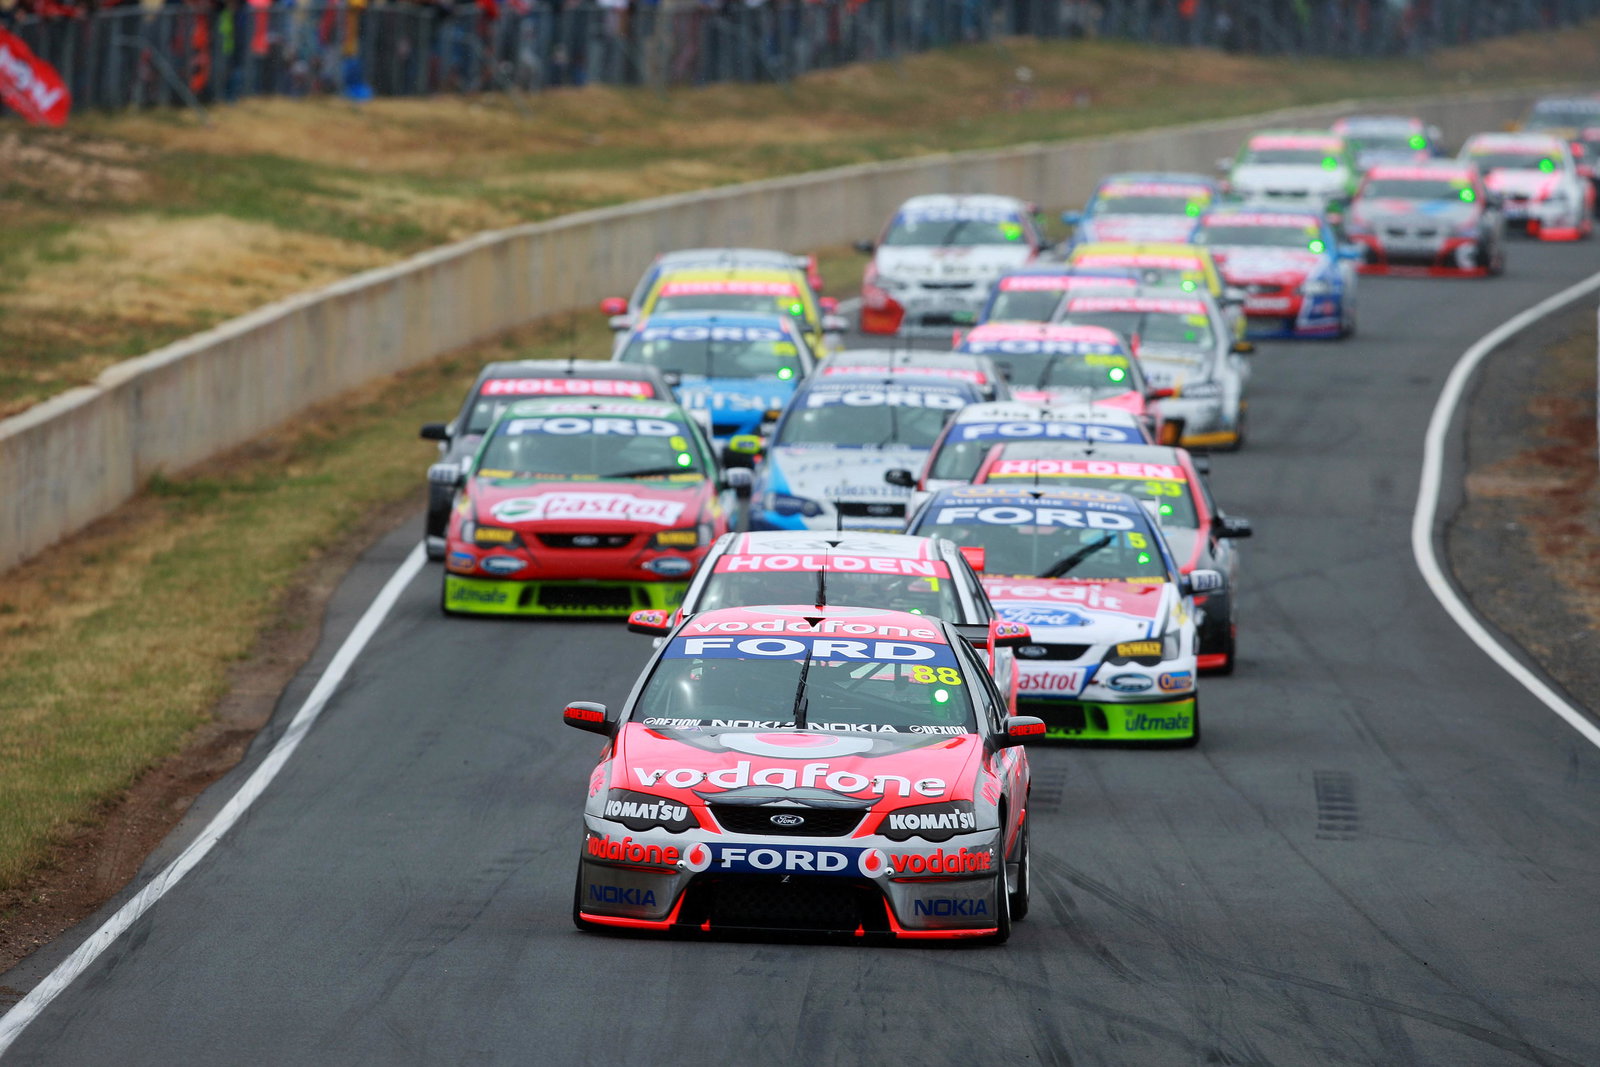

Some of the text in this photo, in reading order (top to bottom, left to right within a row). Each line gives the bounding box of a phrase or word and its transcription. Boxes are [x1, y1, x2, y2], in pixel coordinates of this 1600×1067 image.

[642, 327, 782, 341] FORD
[489, 379, 642, 396] HOLDEN
[807, 391, 965, 410] FORD
[506, 418, 679, 437] FORD
[962, 422, 1128, 442] FORD
[999, 460, 1174, 478] HOLDEN
[1145, 481, 1182, 498] 33
[541, 492, 671, 518] Castrol
[936, 506, 1135, 530] FORD
[1127, 532, 1147, 549] 5
[726, 554, 936, 577] HOLDEN
[923, 577, 939, 592] 1
[988, 584, 1122, 610] redit
[1004, 607, 1071, 625] Ford
[693, 618, 936, 639] vodafone
[684, 637, 936, 661] FORD
[912, 665, 962, 686] 88
[1018, 671, 1078, 691] astrol
[655, 719, 701, 727] DEXION
[808, 723, 899, 733] NOKIA
[922, 725, 969, 735] DEXION
[633, 761, 947, 798] vodafone
[605, 801, 688, 822] KOMATSU
[889, 809, 976, 829] KOMATSU
[588, 834, 680, 865] vodafone
[721, 848, 848, 871] FORD
[890, 848, 991, 873] vodafone
[590, 884, 657, 907] NOKIA
[915, 899, 988, 917] NOKIA
